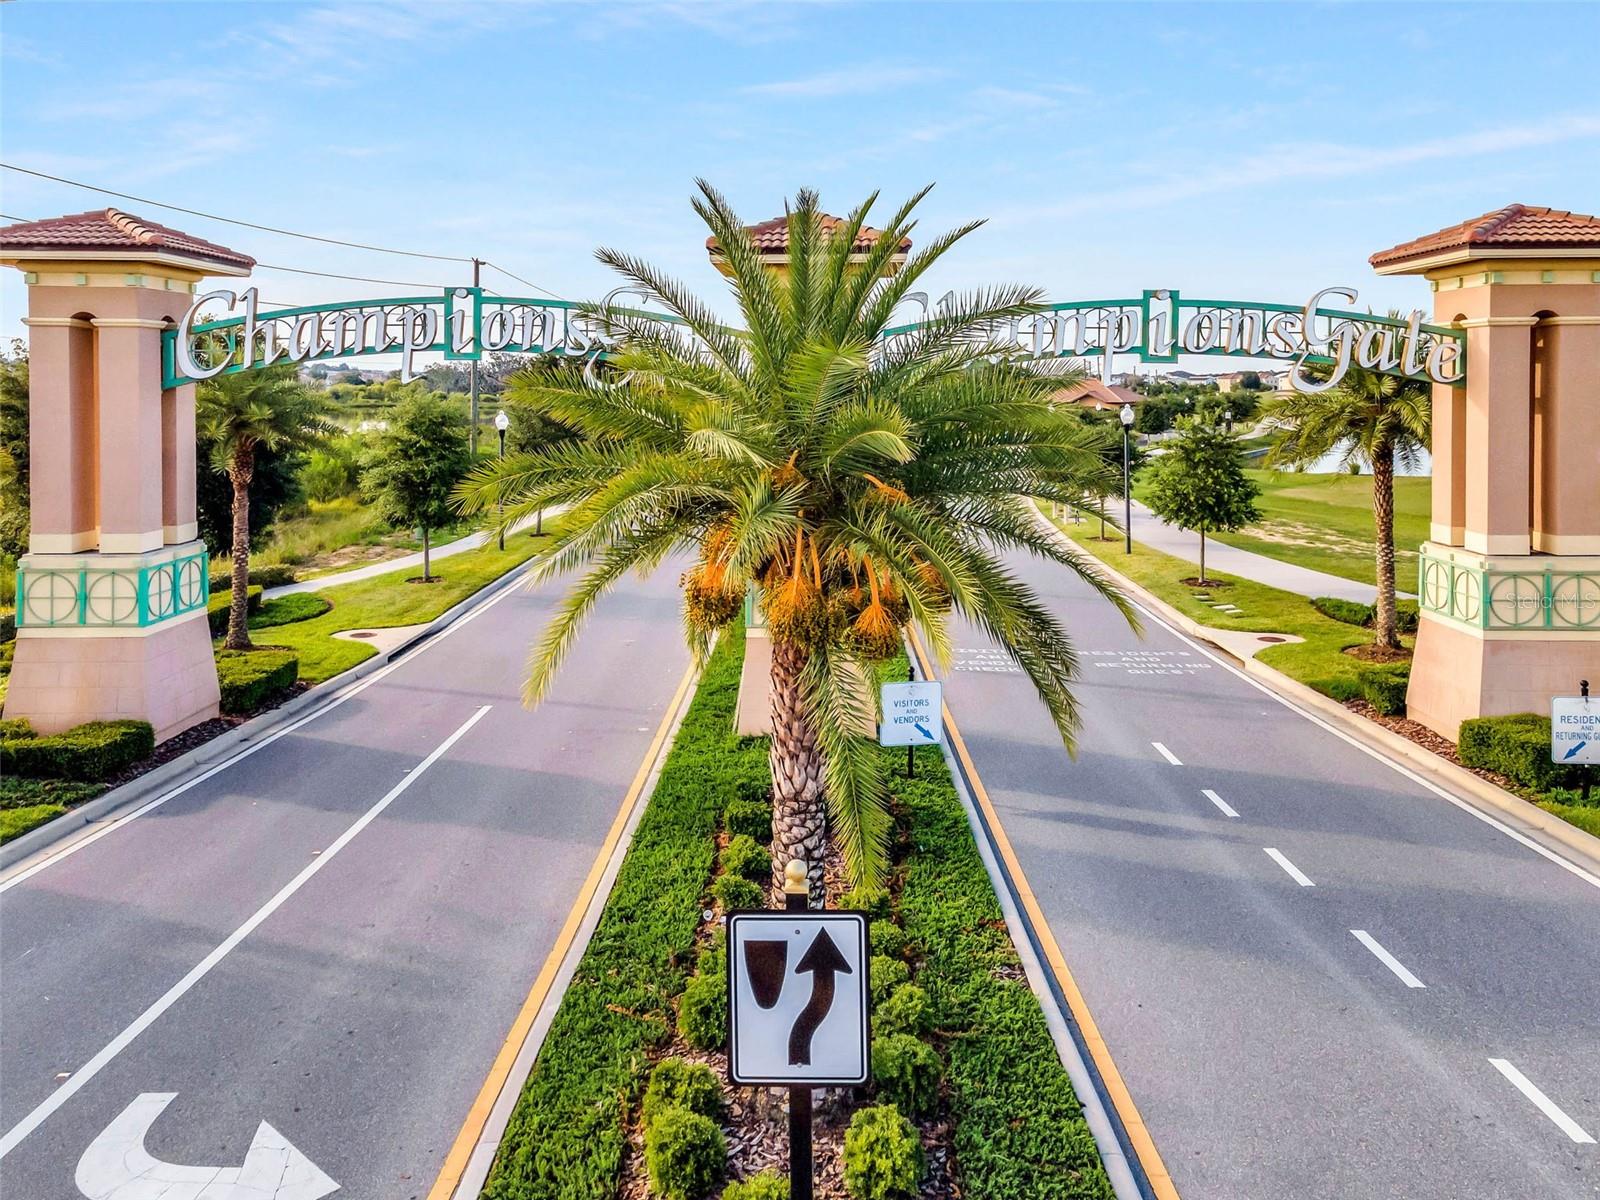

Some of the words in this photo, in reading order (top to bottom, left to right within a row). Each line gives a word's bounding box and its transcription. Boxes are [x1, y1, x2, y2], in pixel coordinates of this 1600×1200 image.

[893, 699, 930, 708] VISITORS
[893, 715, 930, 724] VENDORS
[1555, 731, 1592, 741] RETURNING
